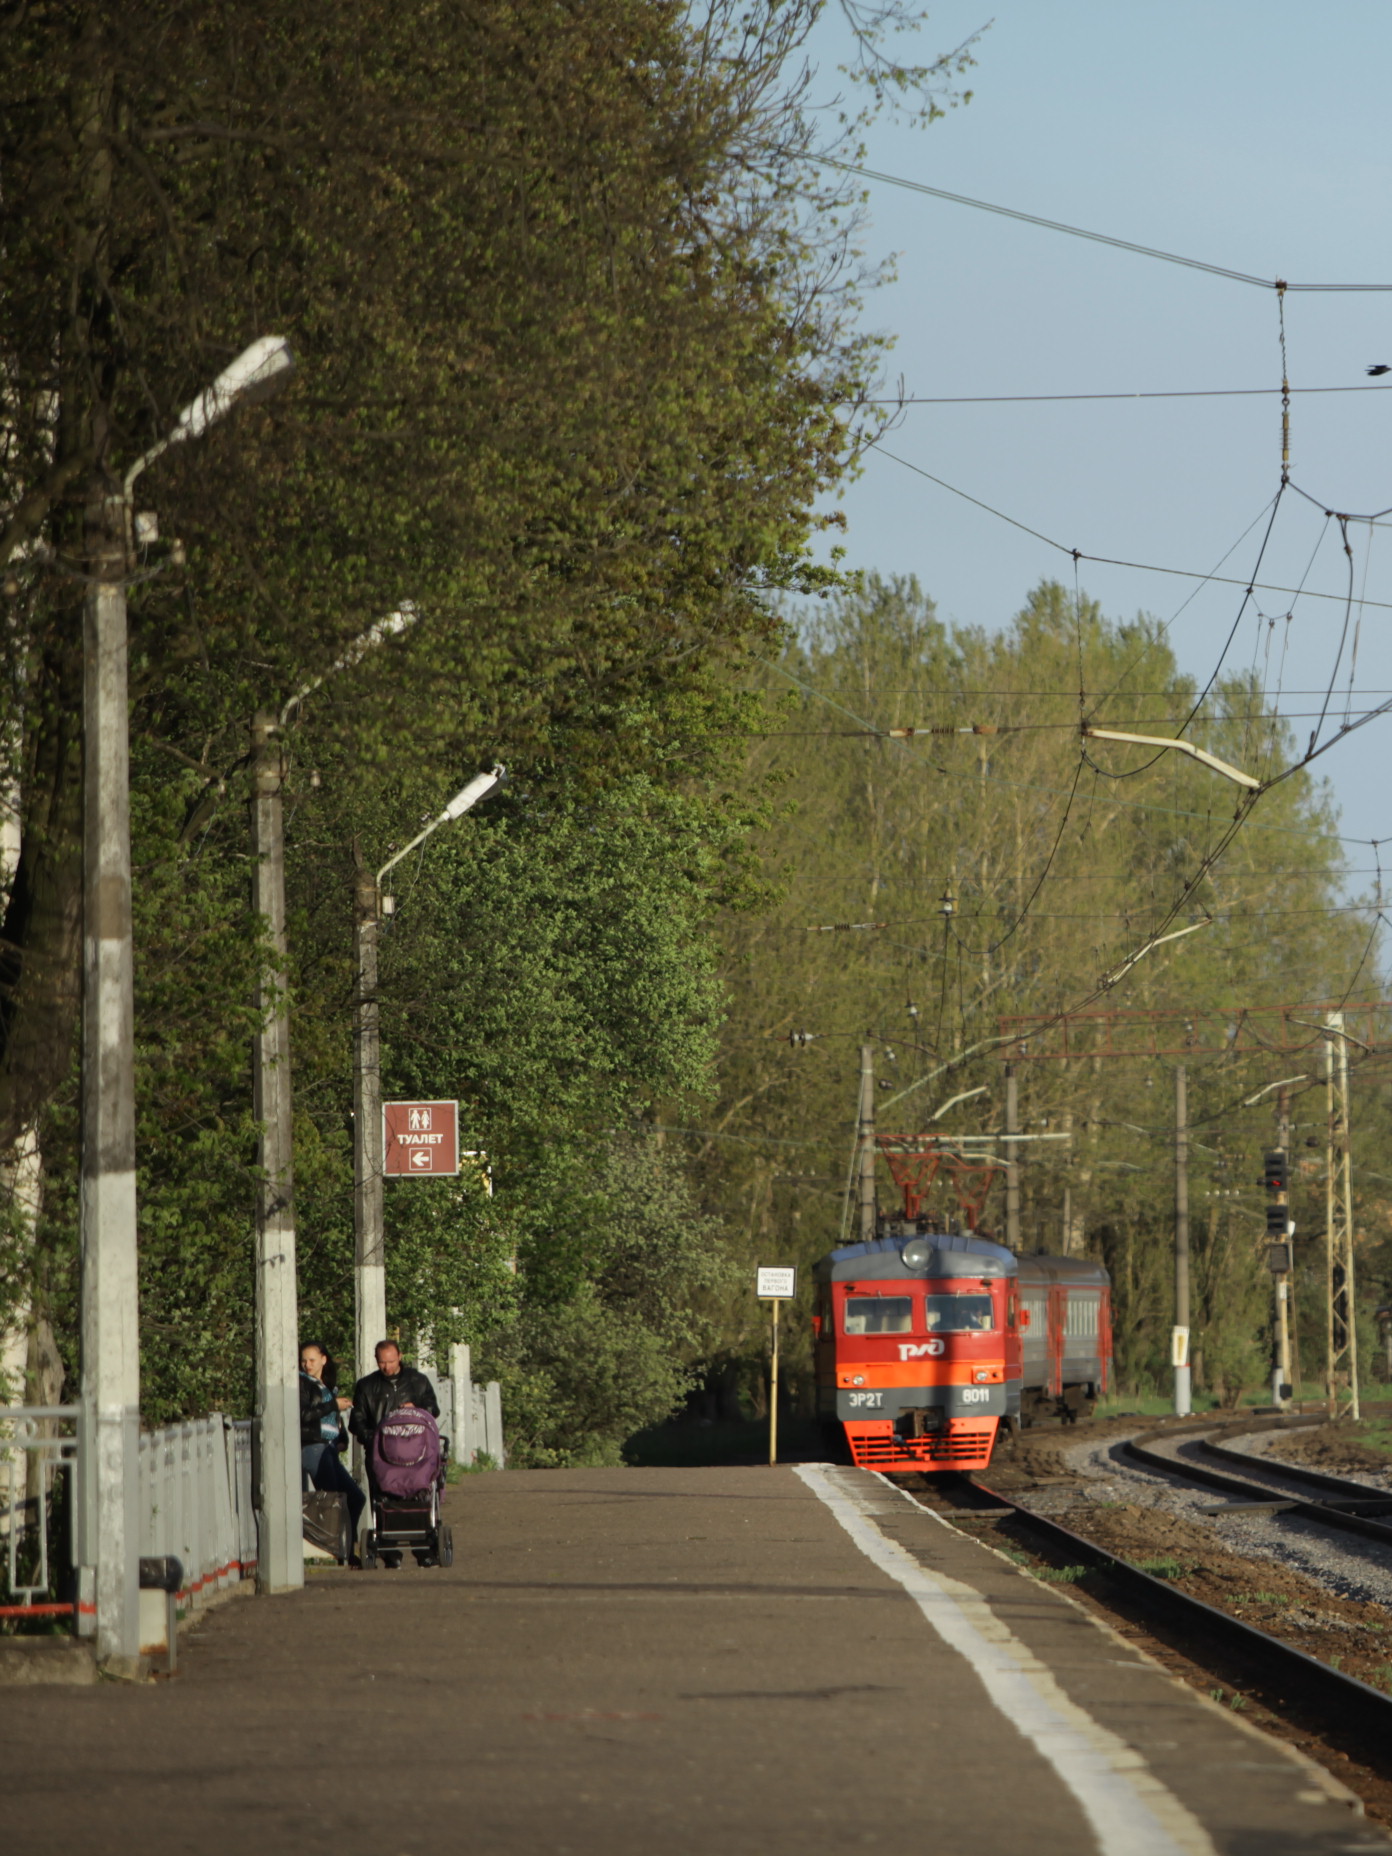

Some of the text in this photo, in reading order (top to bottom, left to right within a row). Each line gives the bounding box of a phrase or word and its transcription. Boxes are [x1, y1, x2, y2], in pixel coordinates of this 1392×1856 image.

[397, 1133, 443, 1144] ТУАЛЕТ
[762, 1284, 788, 1292] ВАГОНА
[849, 1392, 883, 1407] ЭР2Т
